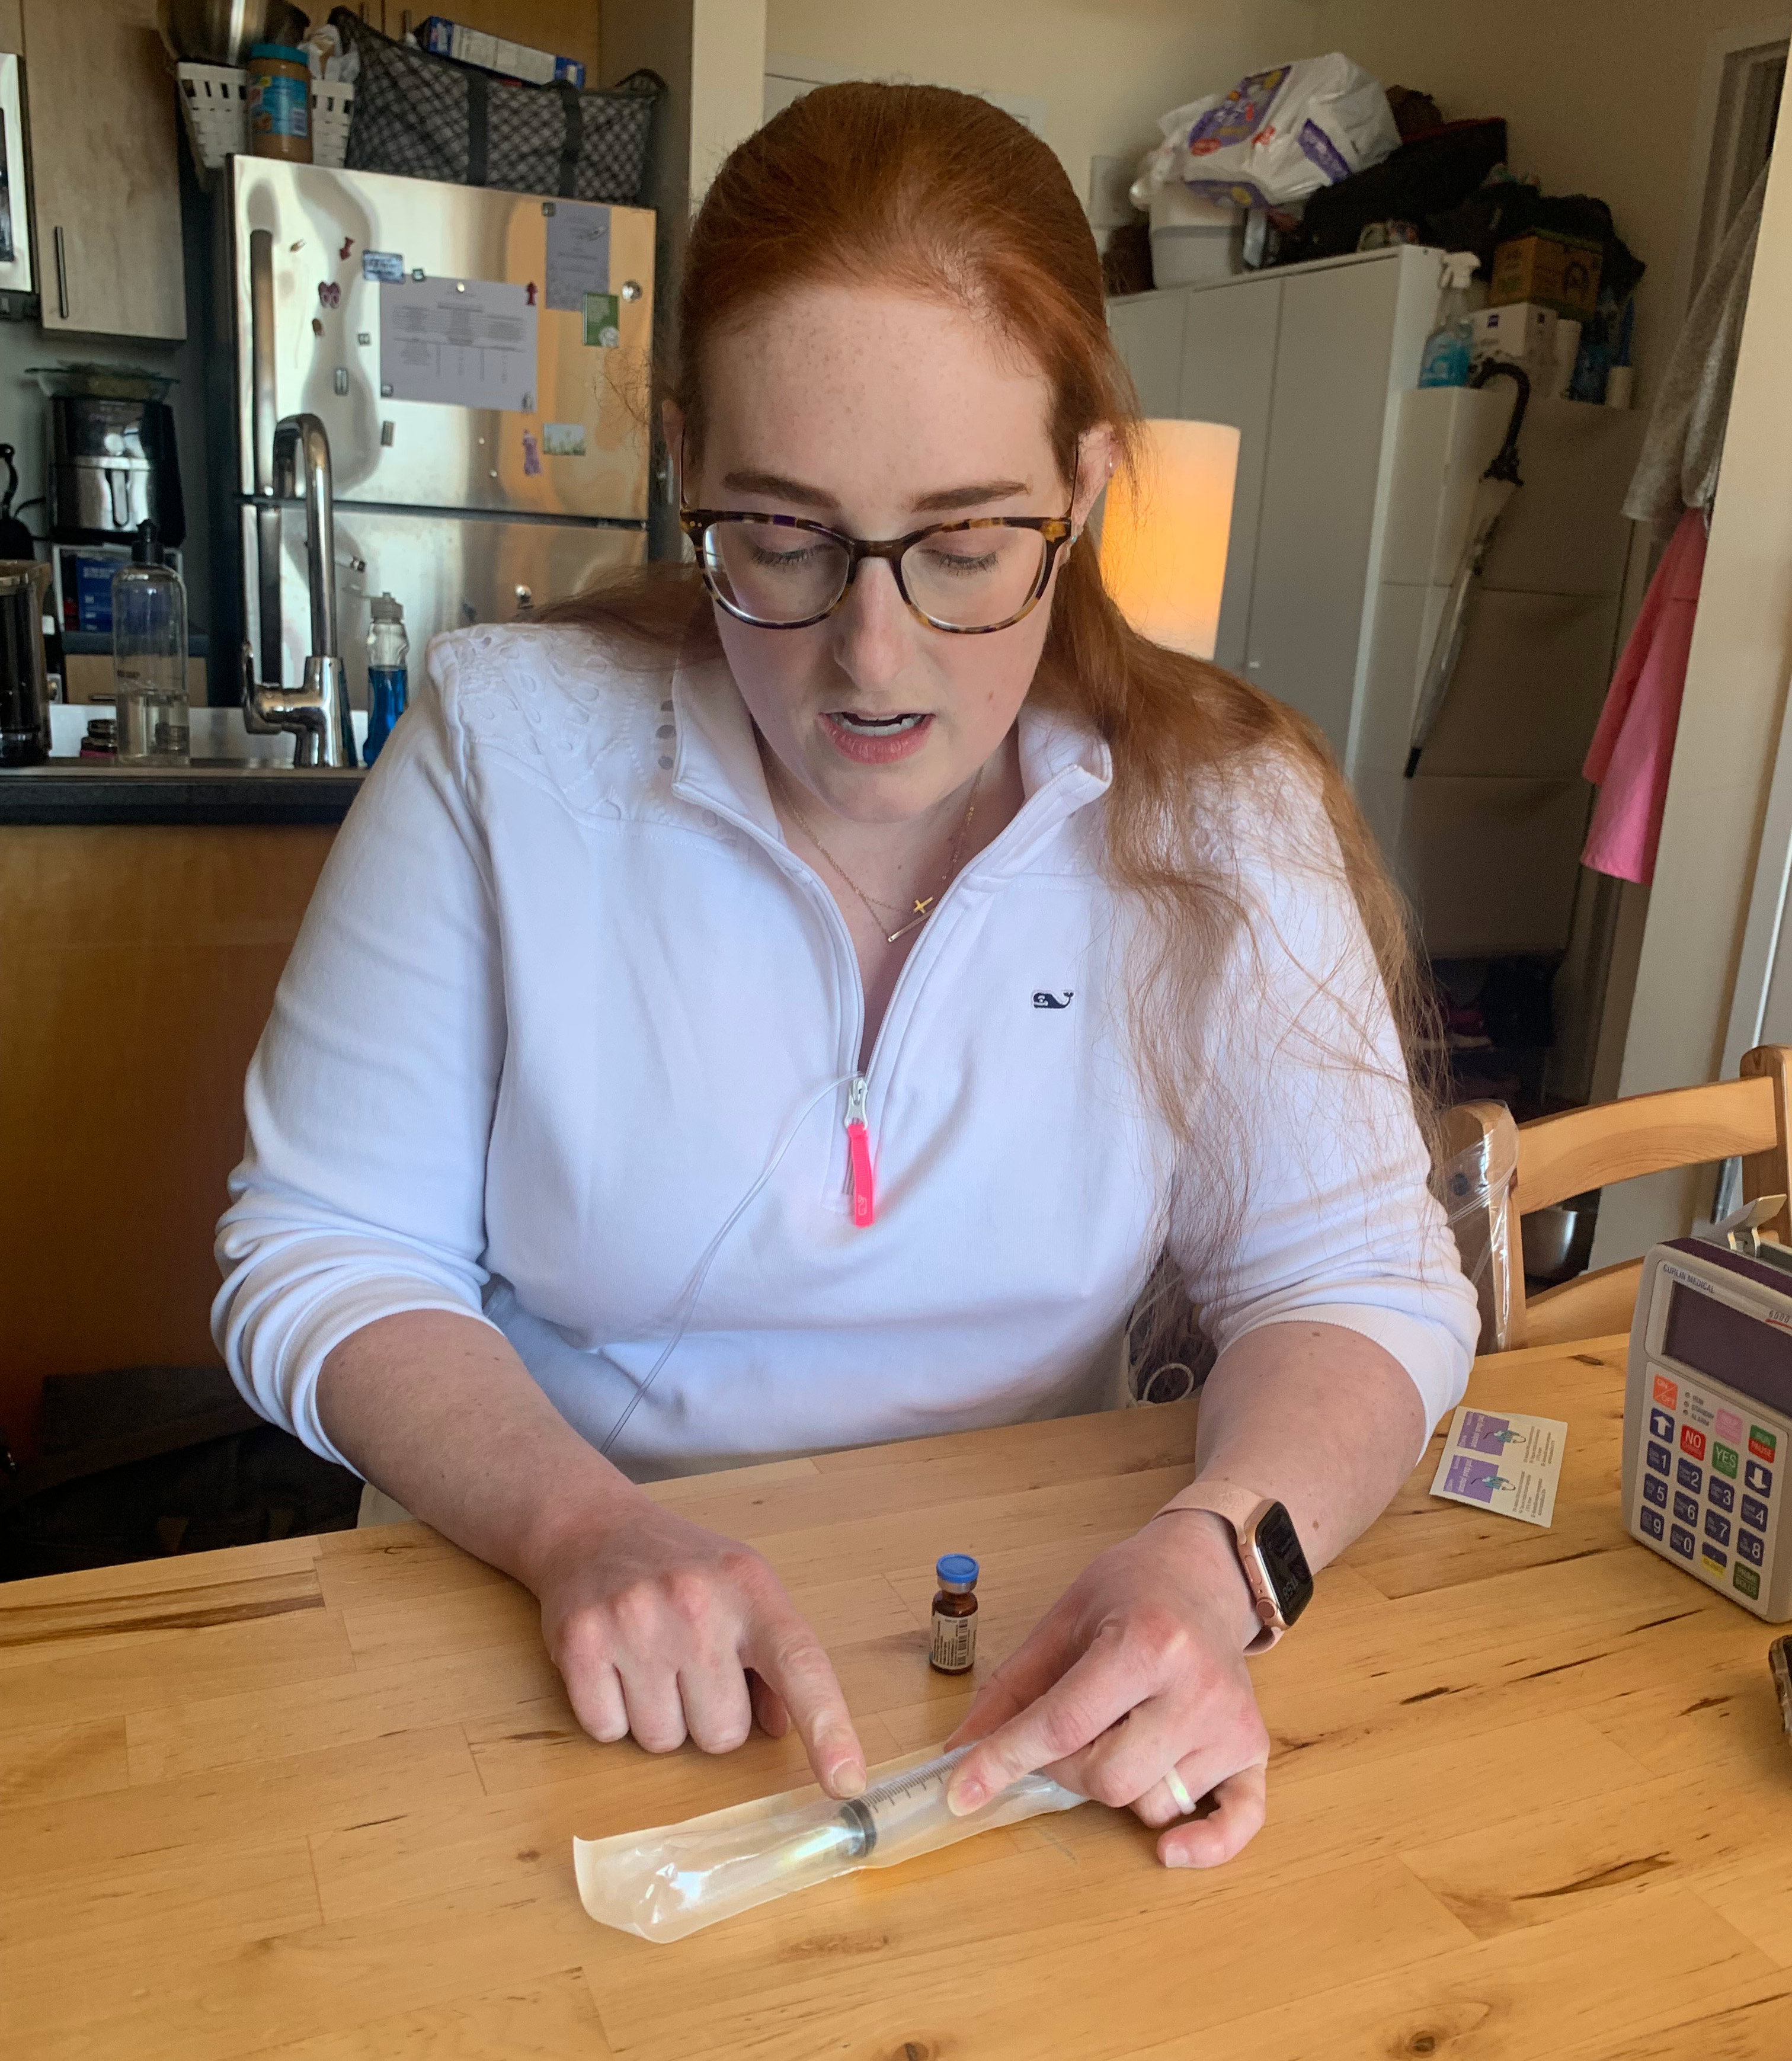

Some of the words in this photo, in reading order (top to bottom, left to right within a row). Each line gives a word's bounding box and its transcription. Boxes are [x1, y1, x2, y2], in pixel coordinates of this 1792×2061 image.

[1663, 1263, 1686, 1281] CURLIN
[1687, 1275, 1714, 1294] MEDICAL
[1685, 1430, 1701, 1448] NO
[1662, 1454, 1666, 1468] 1
[1716, 1446, 1736, 1468] YES
[1691, 1471, 1699, 1487] 2
[1657, 1486, 1665, 1502] 5
[1723, 1489, 1730, 1505] 3
[1687, 1504, 1695, 1520] 6
[1755, 1510, 1764, 1525] 4
[1653, 1518, 1661, 1534] 9
[1720, 1522, 1728, 1537] 7
[1684, 1537, 1692, 1553] 0
[1752, 1542, 1761, 1559] 8
